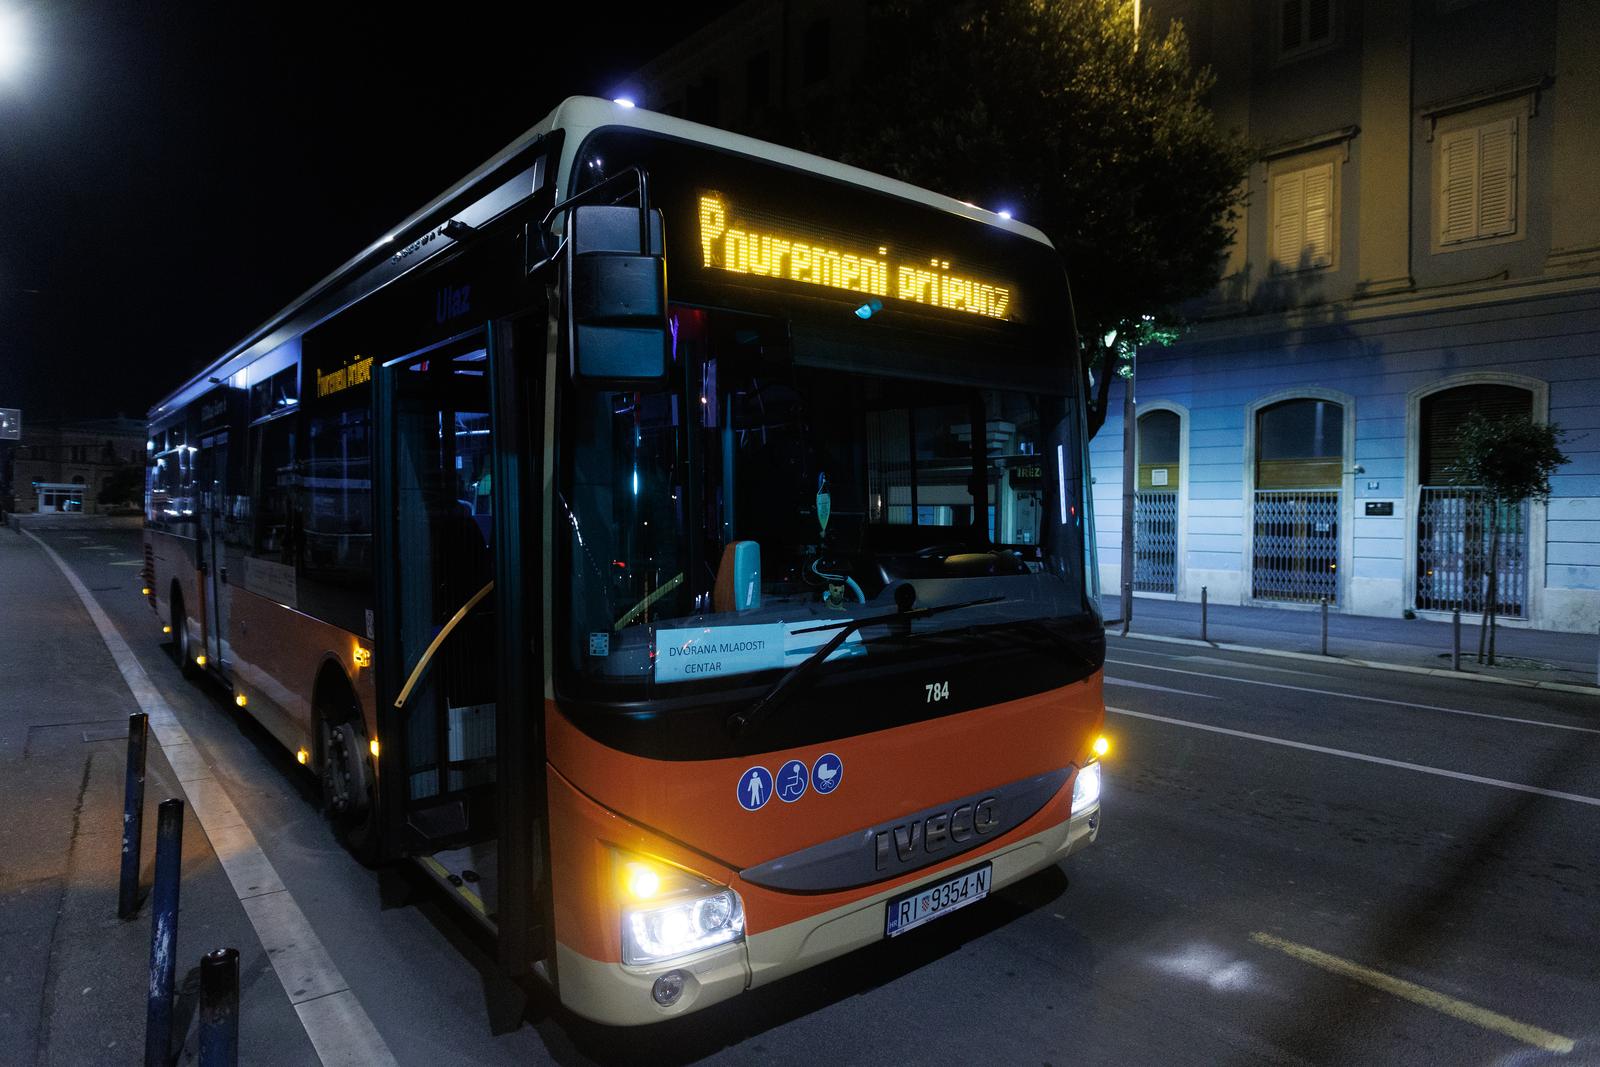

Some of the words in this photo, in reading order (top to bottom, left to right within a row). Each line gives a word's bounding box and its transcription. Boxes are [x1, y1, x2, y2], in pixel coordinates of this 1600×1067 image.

[669, 644, 717, 657] DVORANA
[719, 640, 766, 653] MLADOSTI
[684, 661, 722, 674] CENTAR
[925, 681, 949, 703] 784
[875, 796, 1000, 871] IVECO
[900, 897, 918, 926] RI
[931, 870, 986, 912] 9354-N
